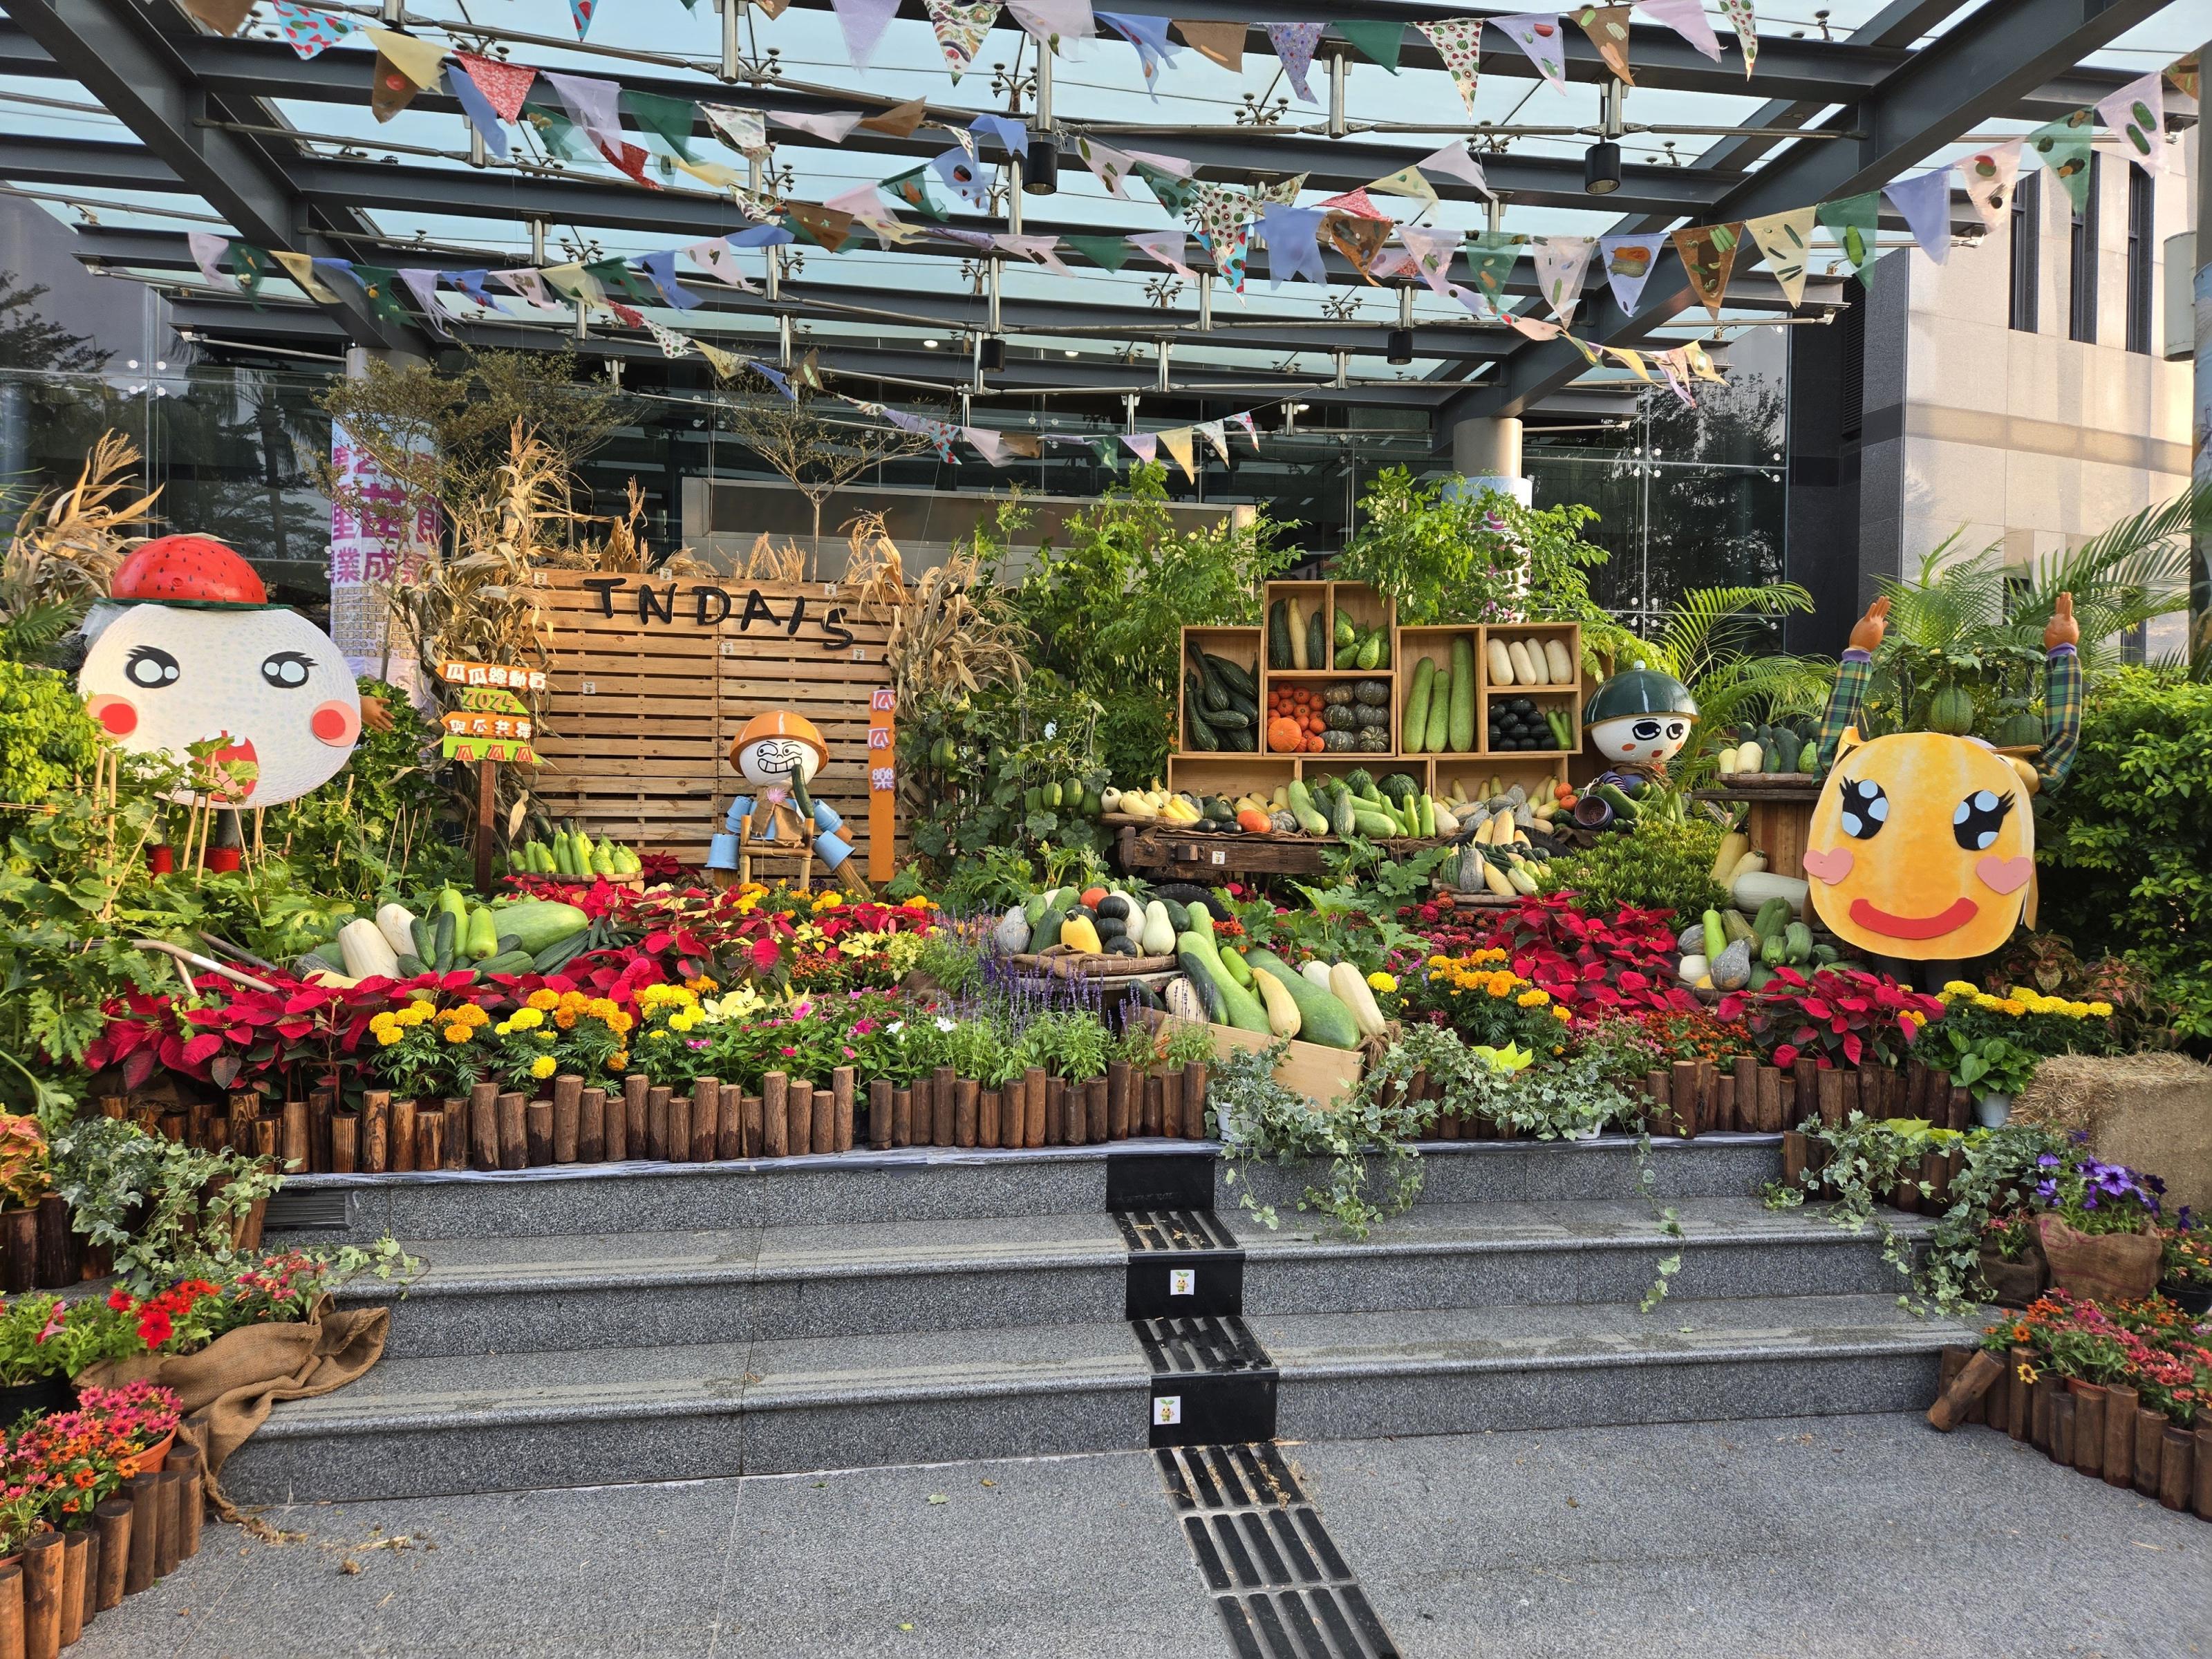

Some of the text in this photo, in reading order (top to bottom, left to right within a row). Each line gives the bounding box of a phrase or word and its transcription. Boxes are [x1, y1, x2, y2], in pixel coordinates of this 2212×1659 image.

[583, 577, 854, 651] TNDAIS
[464, 690, 516, 712] 2025
[448, 719, 532, 739] 與瓜共舞
[867, 688, 896, 791] 瓜瓜樂
